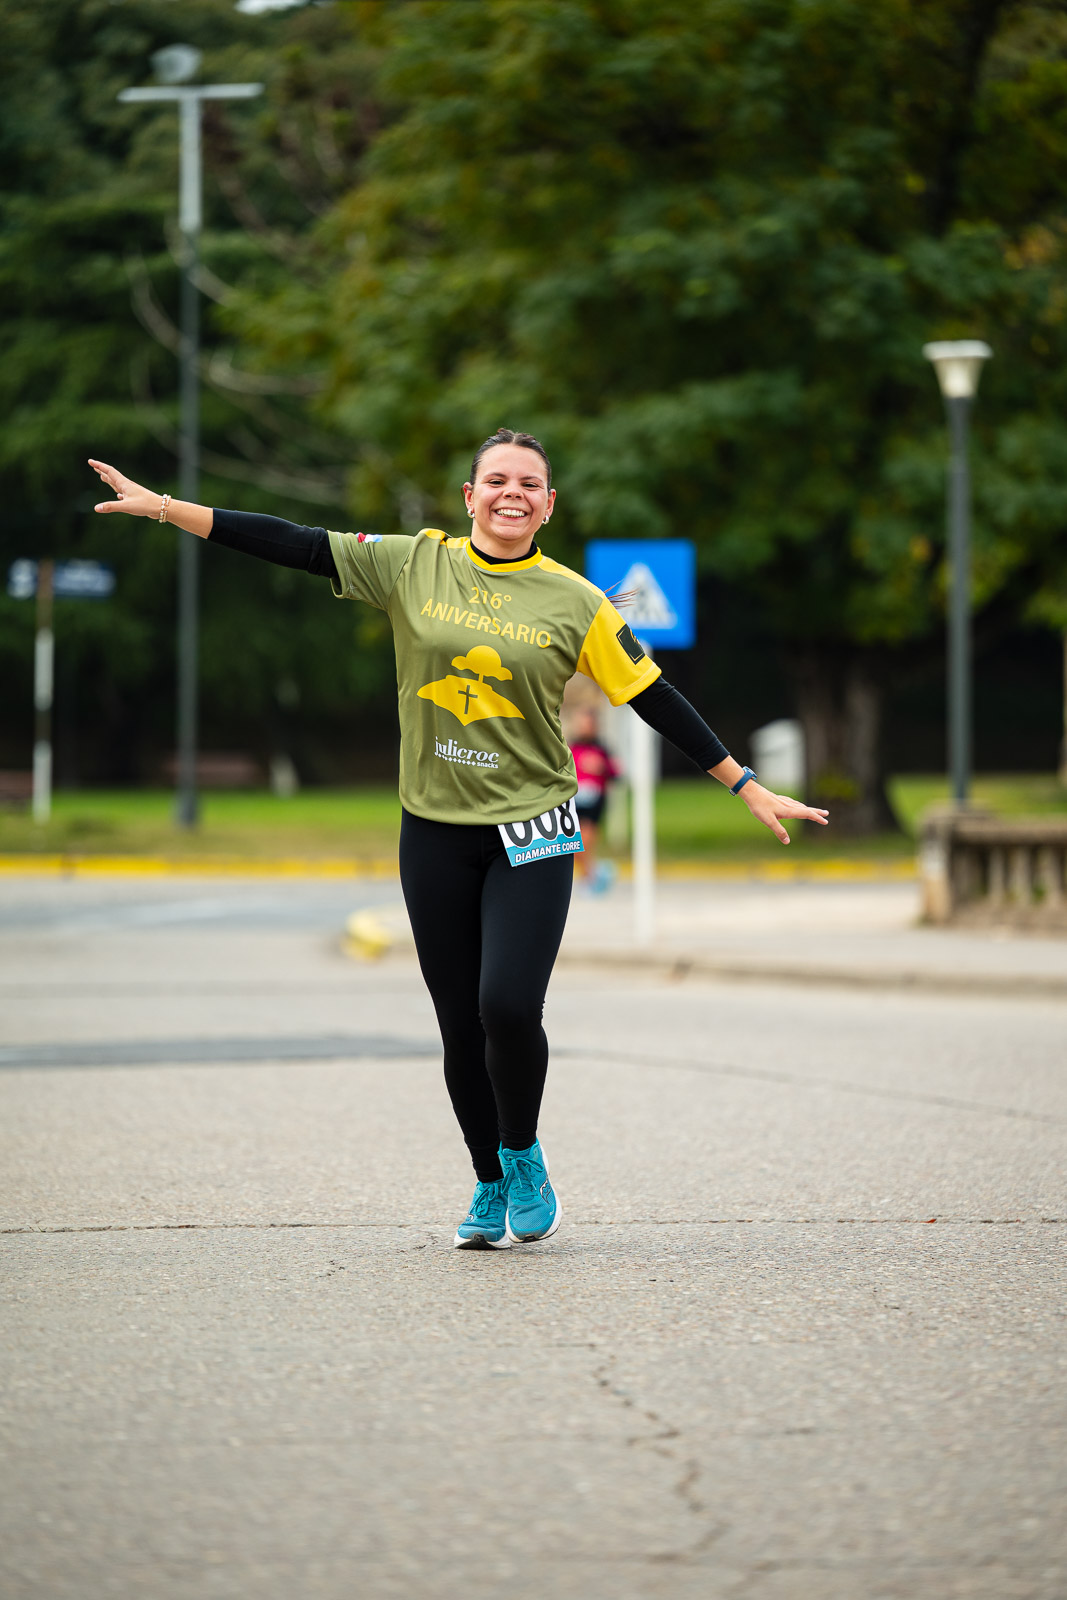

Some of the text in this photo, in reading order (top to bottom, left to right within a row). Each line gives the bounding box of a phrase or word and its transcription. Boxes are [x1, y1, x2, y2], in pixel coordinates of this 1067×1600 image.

[468, 586, 512, 610] 216°
[420, 598, 552, 649] ANIVERSARIO
[434, 736, 500, 763] julicroc
[476, 761, 499, 769] snacks
[514, 840, 581, 863] DIAMANTE CORRE
